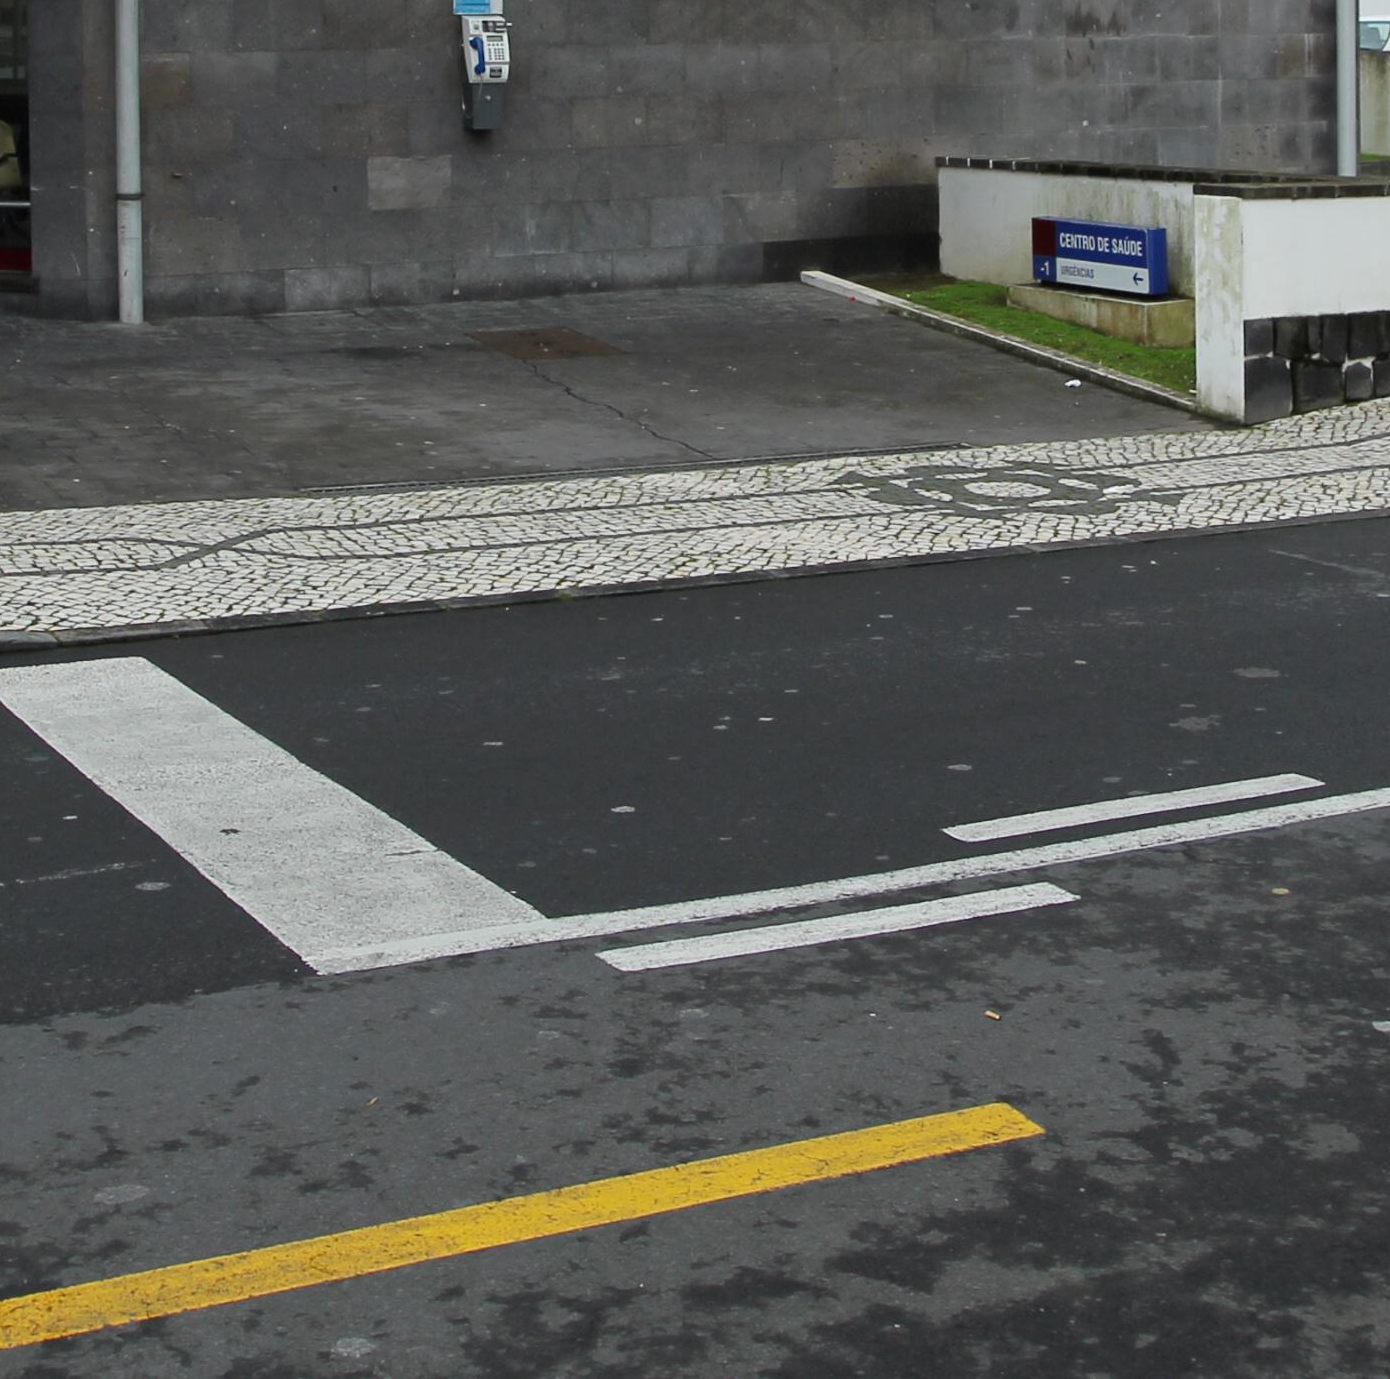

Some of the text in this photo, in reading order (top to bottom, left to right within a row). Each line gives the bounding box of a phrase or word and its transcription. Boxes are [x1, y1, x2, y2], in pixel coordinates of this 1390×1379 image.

[1059, 232, 1143, 256] CENTRO DE SAÚDE
